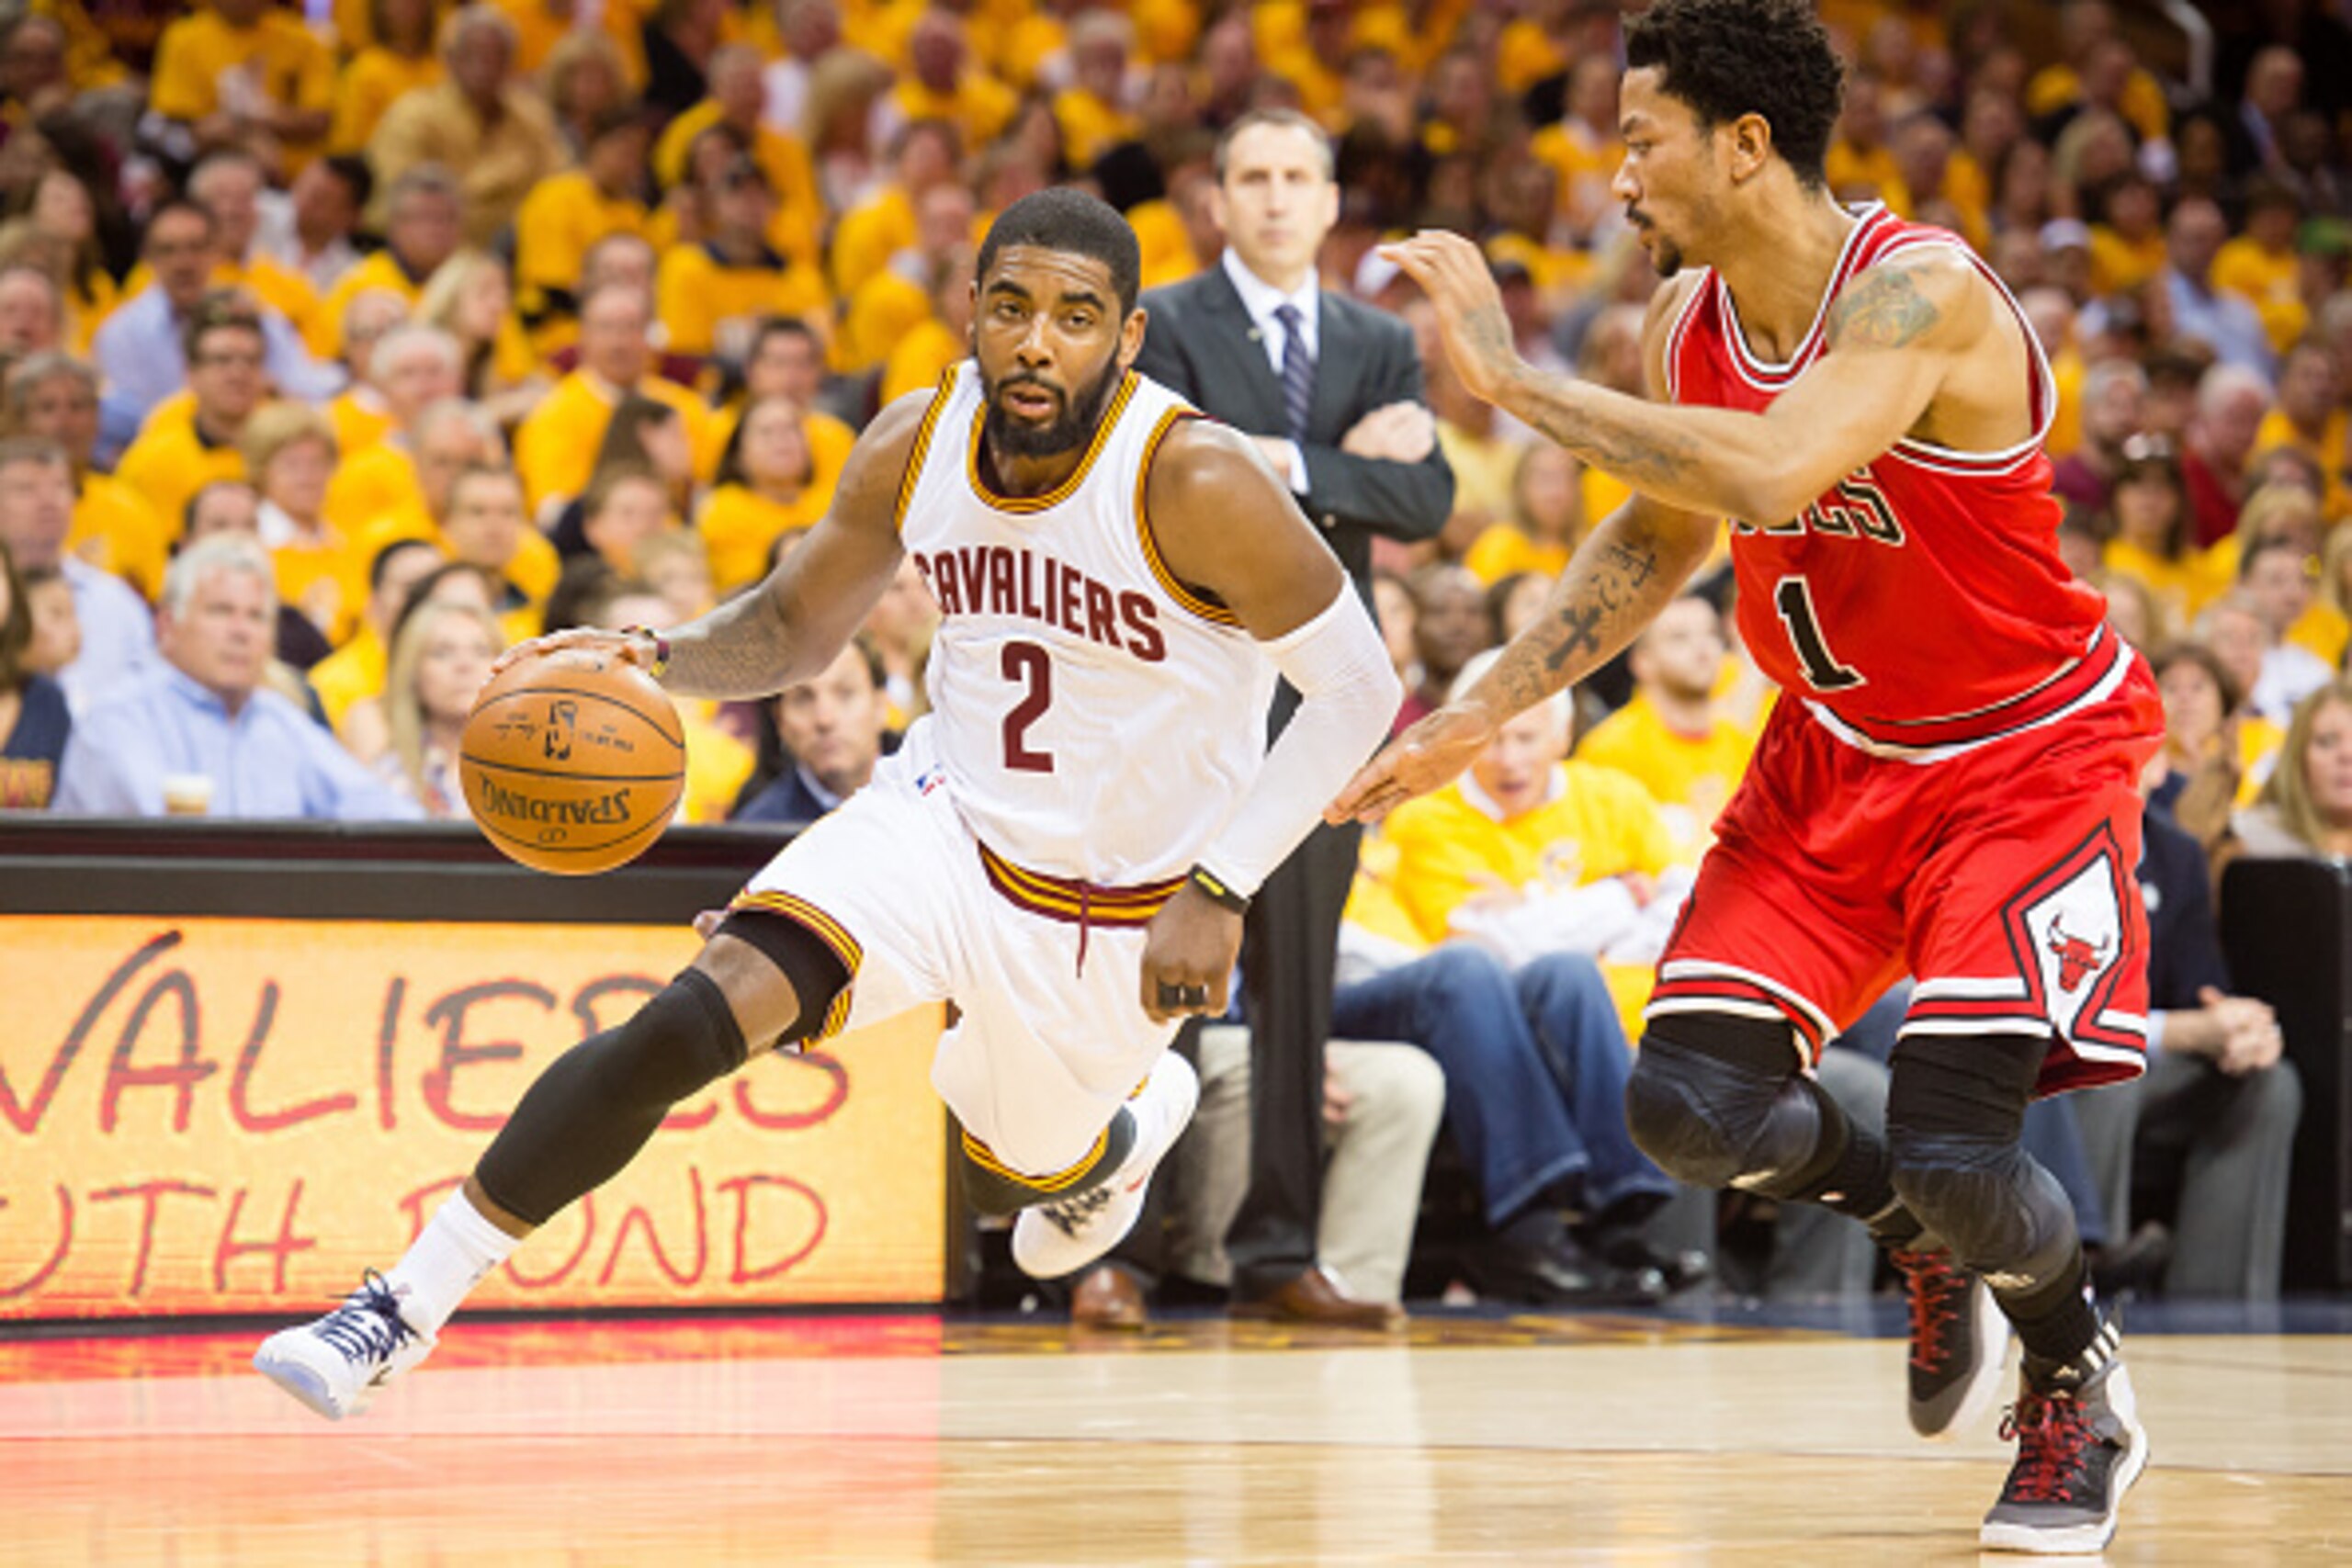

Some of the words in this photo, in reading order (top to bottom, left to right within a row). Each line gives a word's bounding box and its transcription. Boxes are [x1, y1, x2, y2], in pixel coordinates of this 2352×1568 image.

[1774, 575, 1867, 693] 1
[1001, 640, 1055, 773] 2
[480, 773, 630, 824] SPALDING
